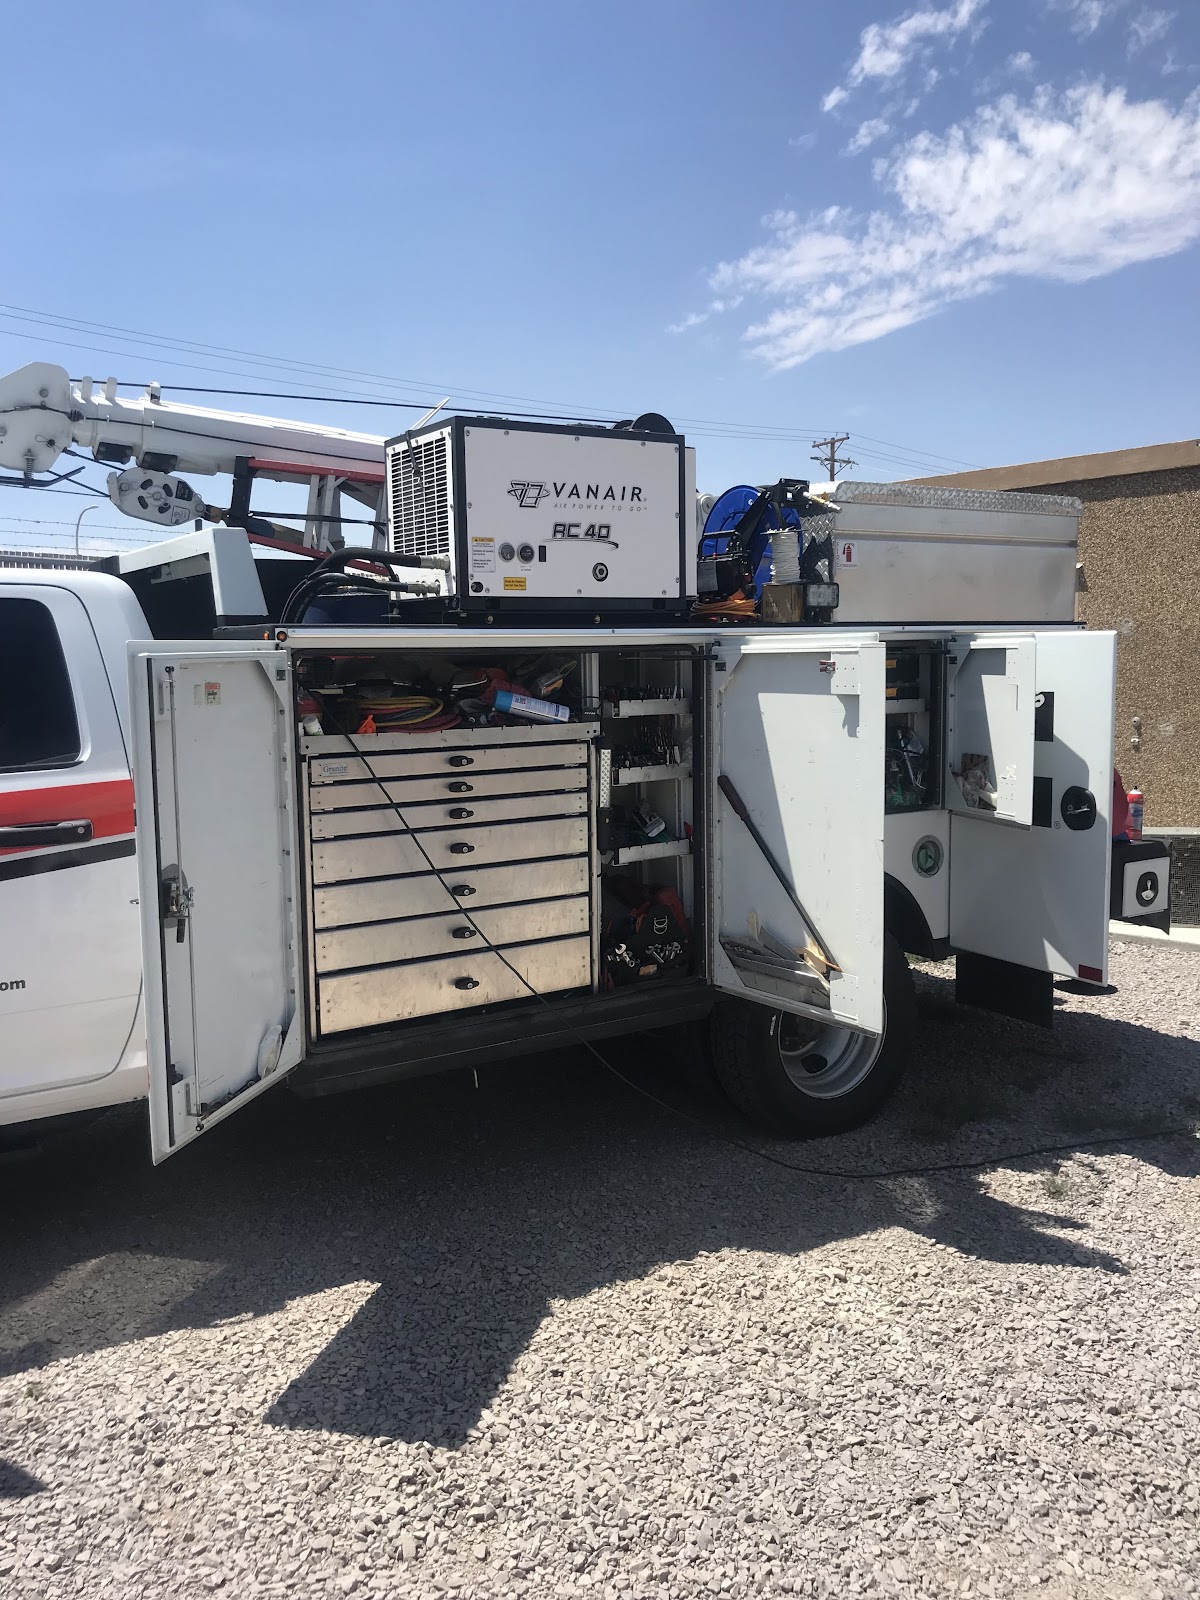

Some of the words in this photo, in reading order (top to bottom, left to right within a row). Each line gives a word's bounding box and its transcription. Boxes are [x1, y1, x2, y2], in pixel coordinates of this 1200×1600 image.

[553, 482, 642, 501] VANAIR
[584, 524, 611, 540] 40
[323, 765, 347, 773] Granite
